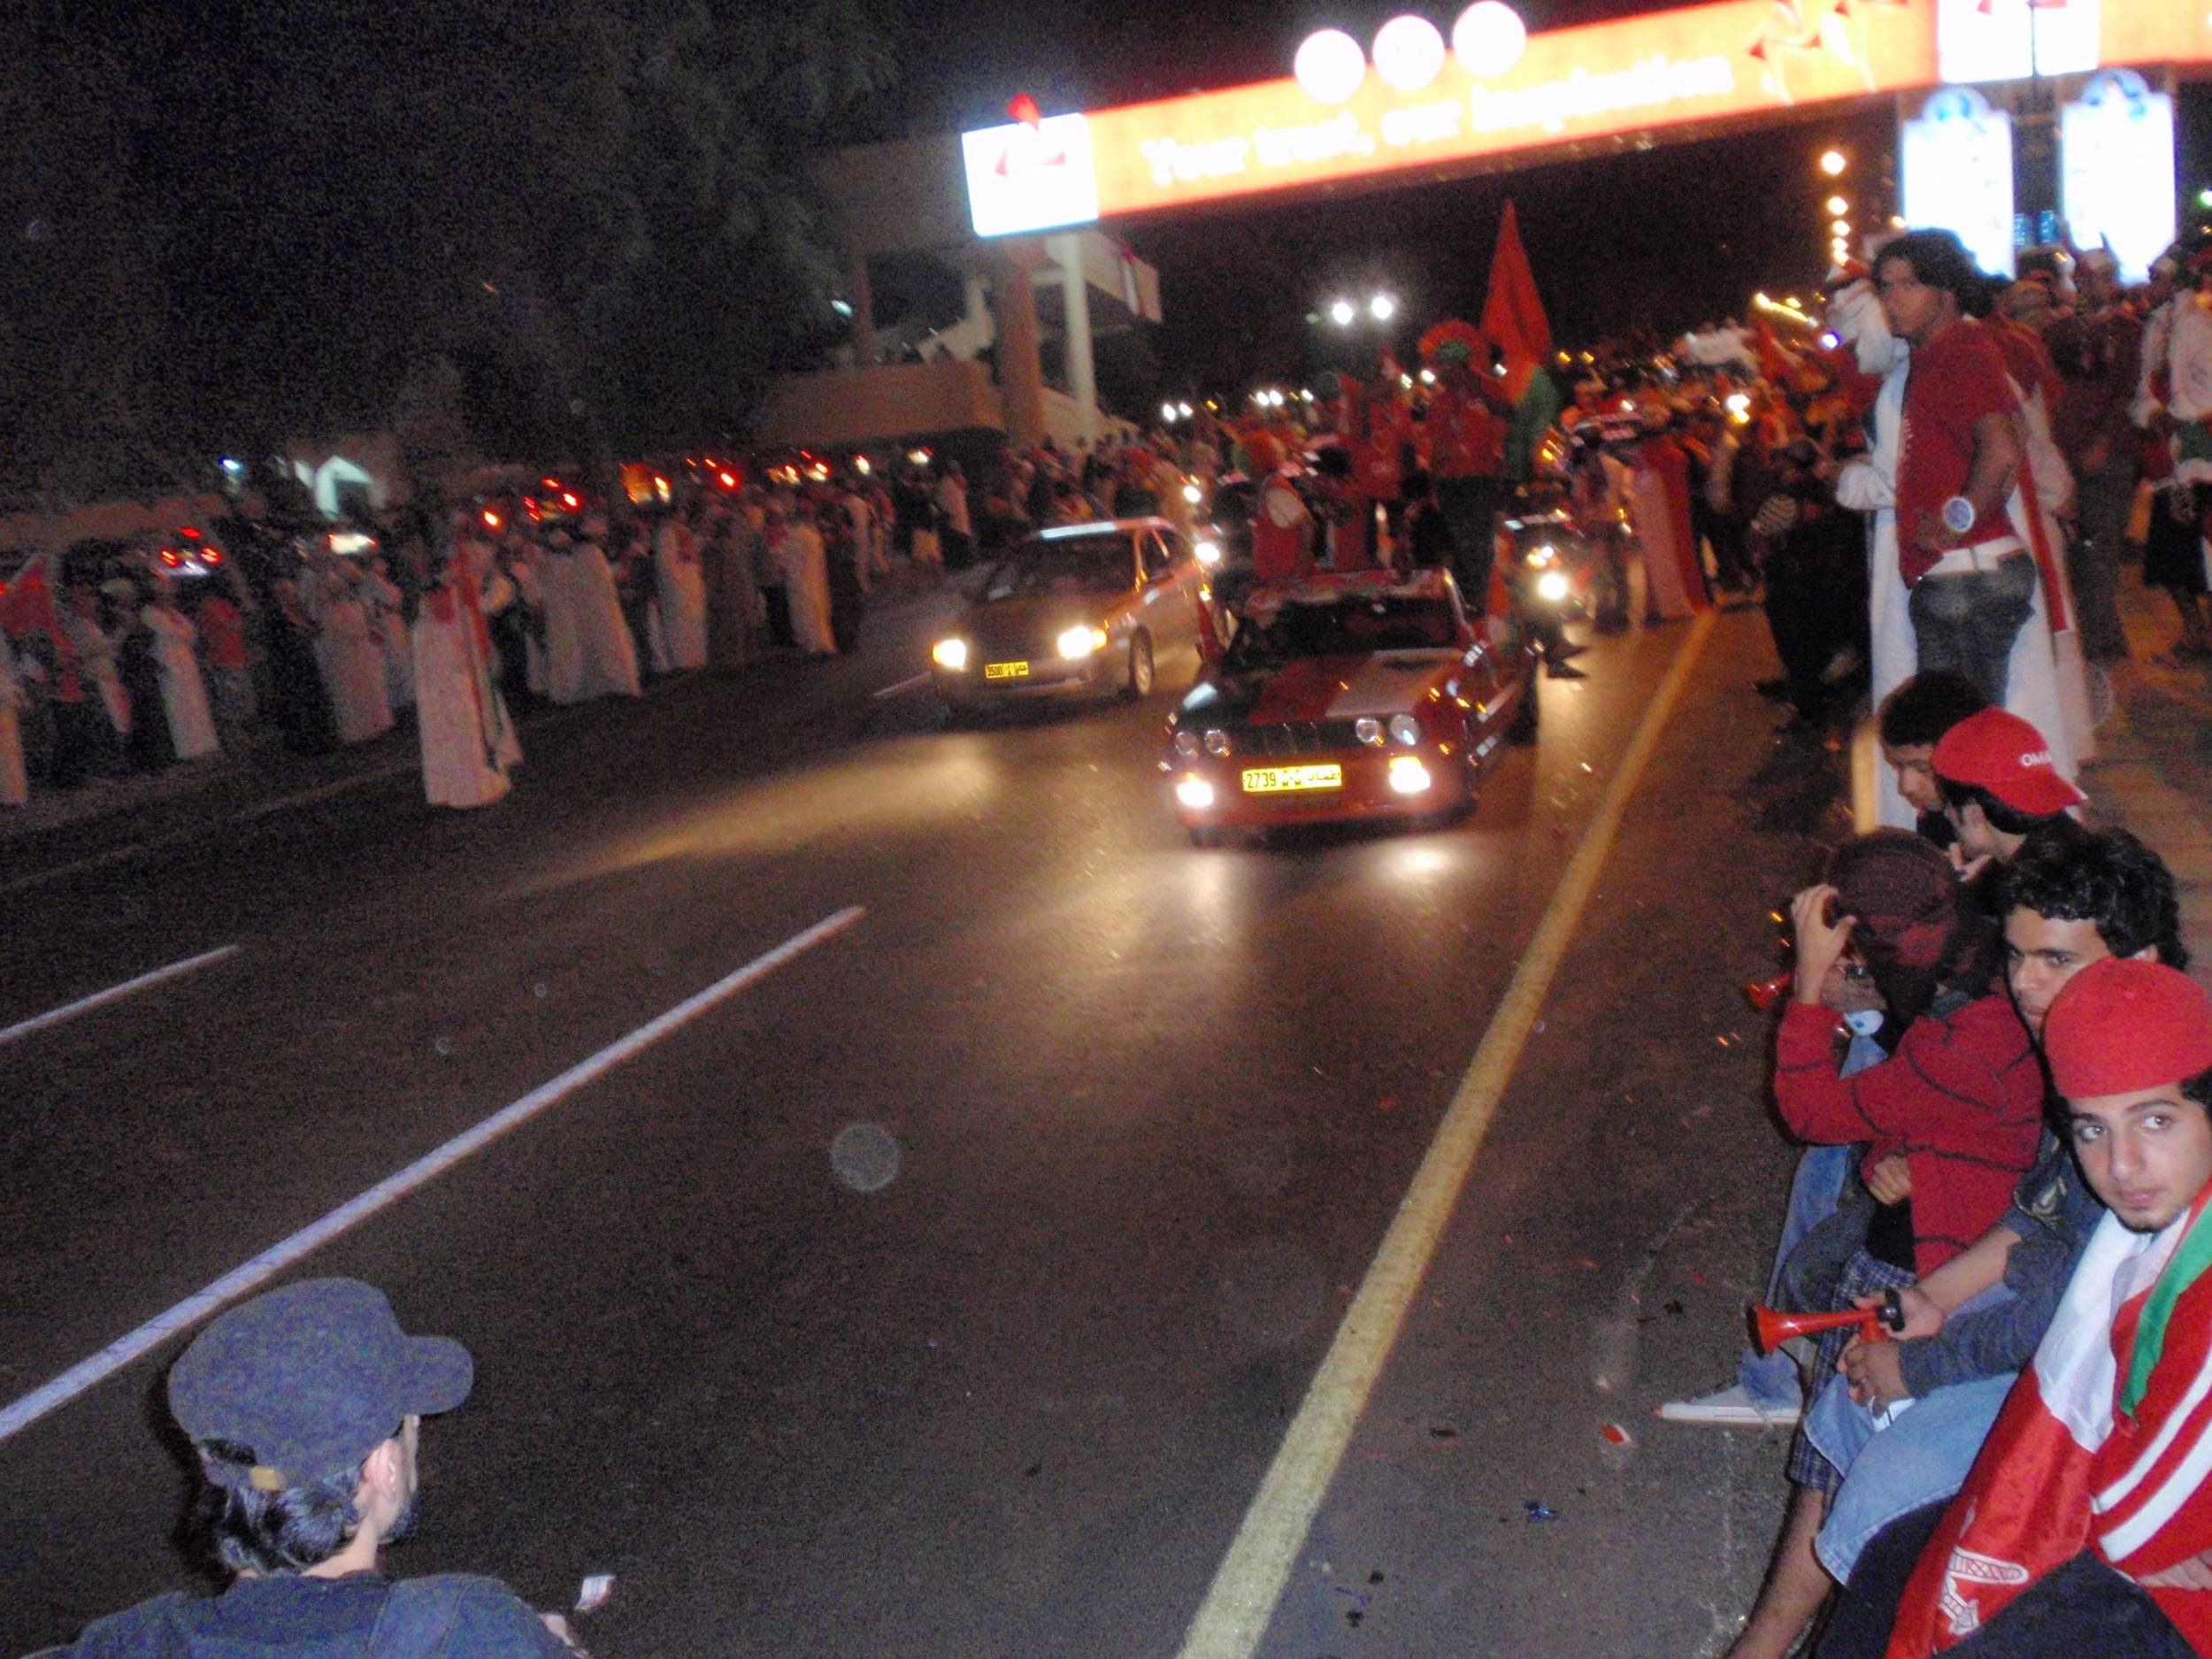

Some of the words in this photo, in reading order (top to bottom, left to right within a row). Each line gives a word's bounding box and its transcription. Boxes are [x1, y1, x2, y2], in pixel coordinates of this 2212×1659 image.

[1140, 136, 1250, 186] Your
[1253, 110, 1377, 166] trust,
[1379, 98, 1465, 147] our
[1246, 771, 1277, 789] 2739
